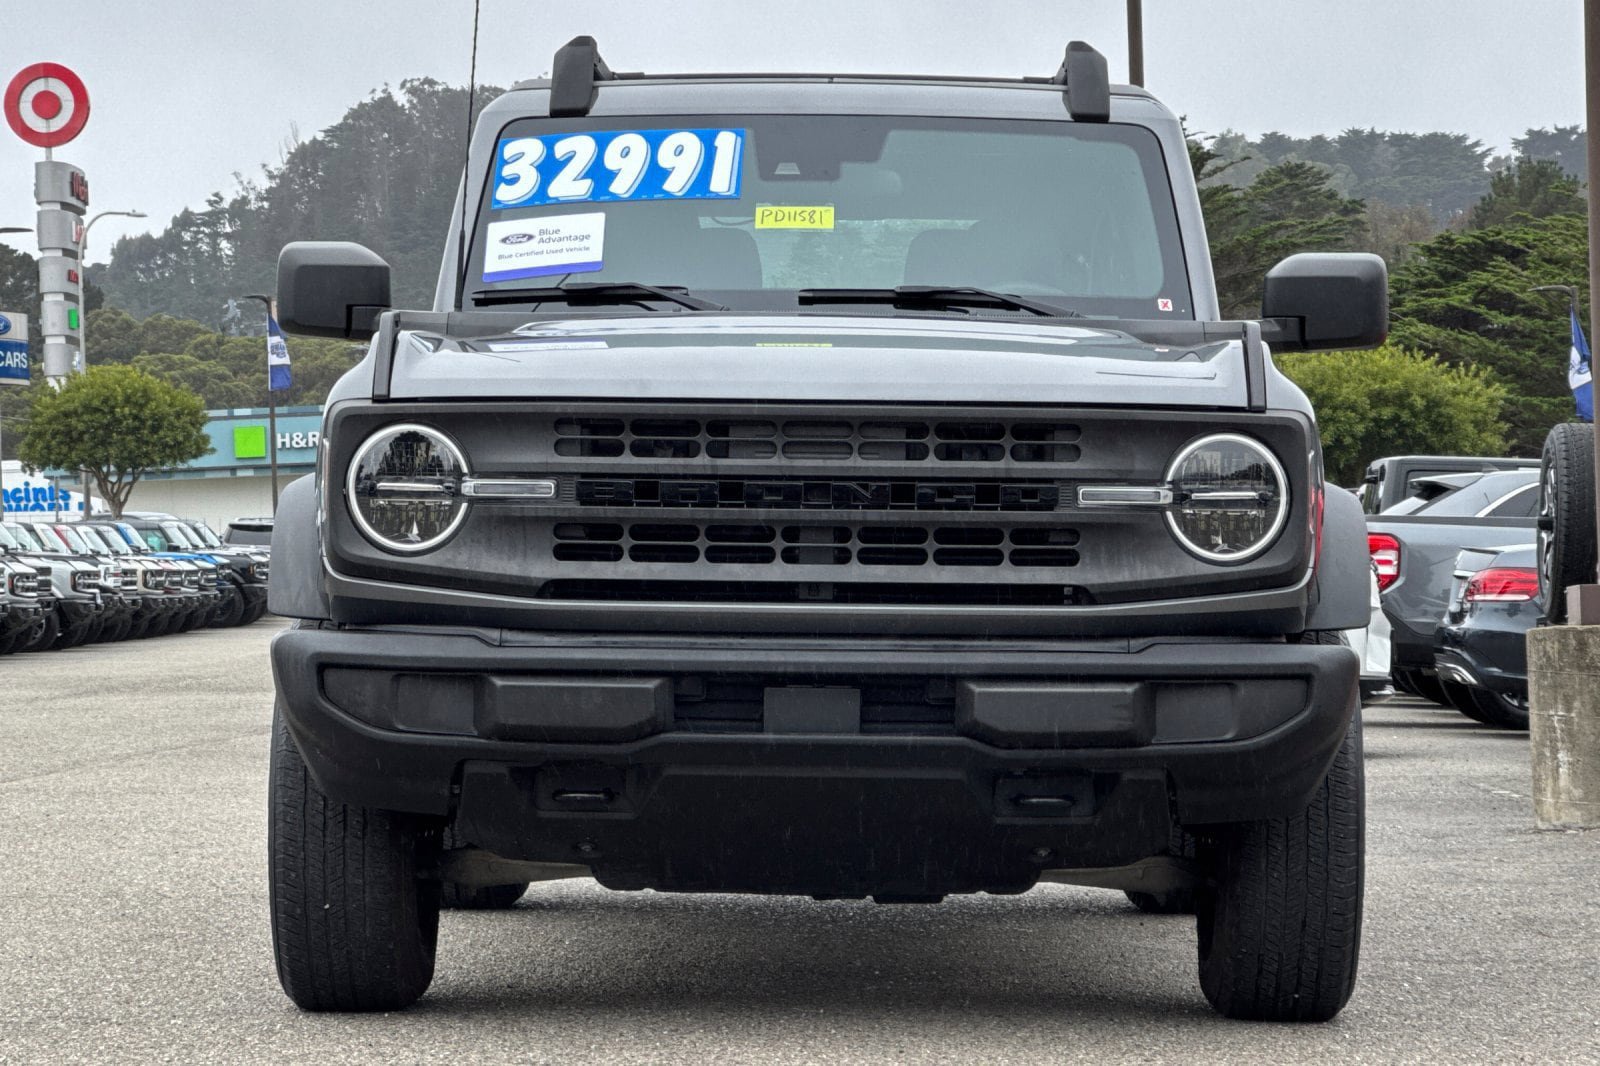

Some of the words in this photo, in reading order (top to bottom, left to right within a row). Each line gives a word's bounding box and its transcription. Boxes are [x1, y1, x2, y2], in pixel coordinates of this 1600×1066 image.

[495, 131, 741, 205] 32991
[760, 208, 824, 225] PD11581
[537, 234, 591, 244] Advantage
[538, 228, 561, 236] Blue
[515, 249, 544, 258] Certified
[545, 247, 564, 255] Used
[277, 431, 320, 449] H&R
